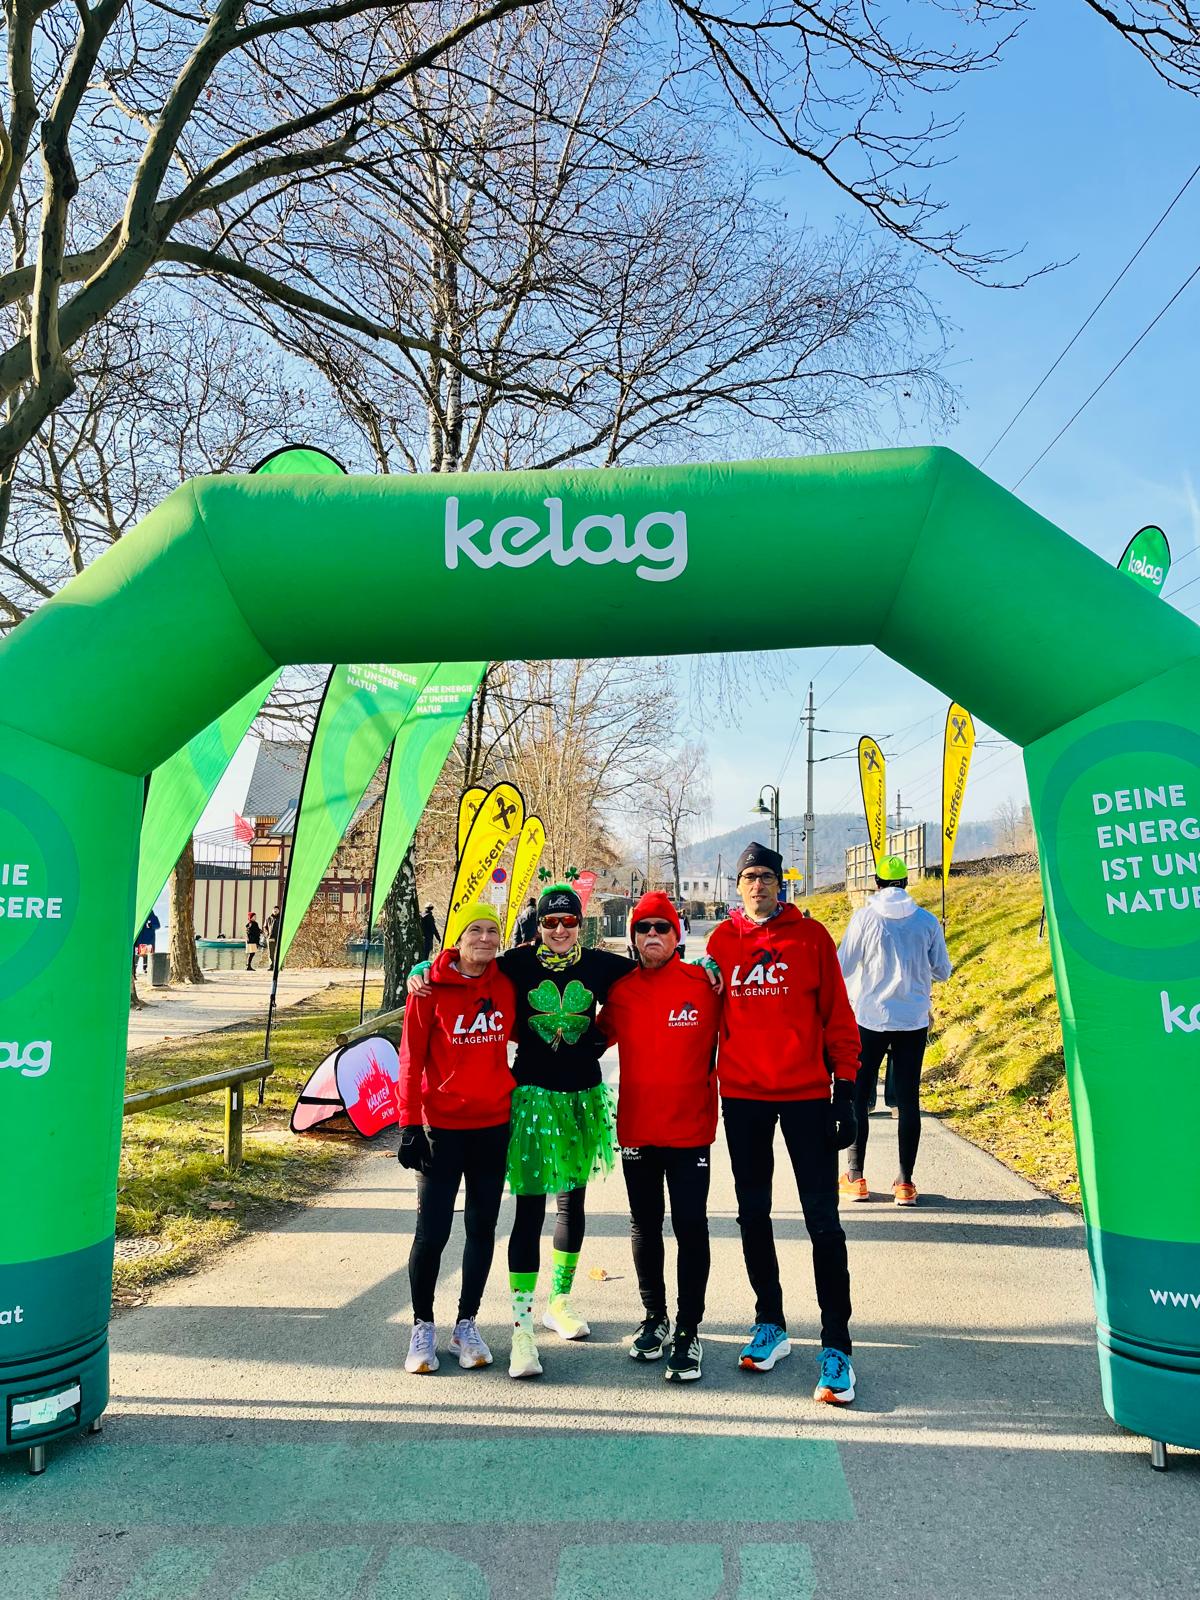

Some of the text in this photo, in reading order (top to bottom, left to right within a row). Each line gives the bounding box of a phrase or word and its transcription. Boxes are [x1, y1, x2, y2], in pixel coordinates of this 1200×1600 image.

[445, 496, 688, 582] kelag
[1128, 550, 1163, 585] kelag
[346, 675, 378, 694] NATUR
[348, 664, 363, 676] IST
[364, 669, 400, 690] UNSERE
[380, 663, 417, 686] ENERGIE
[416, 704, 442, 713] NATUR
[945, 755, 968, 841] Raiffeisen
[1092, 784, 1187, 816] DEINE
[873, 779, 883, 850] Raiffeisen
[453, 838, 504, 914] Raiffeisen
[1101, 852, 1200, 882] IST UN
[511, 853, 537, 911] Raiffeisen
[731, 962, 789, 987] LAC
[453, 1011, 504, 1035] LAC
[668, 1009, 698, 1022] LAC
[622, 1147, 639, 1156] AC
